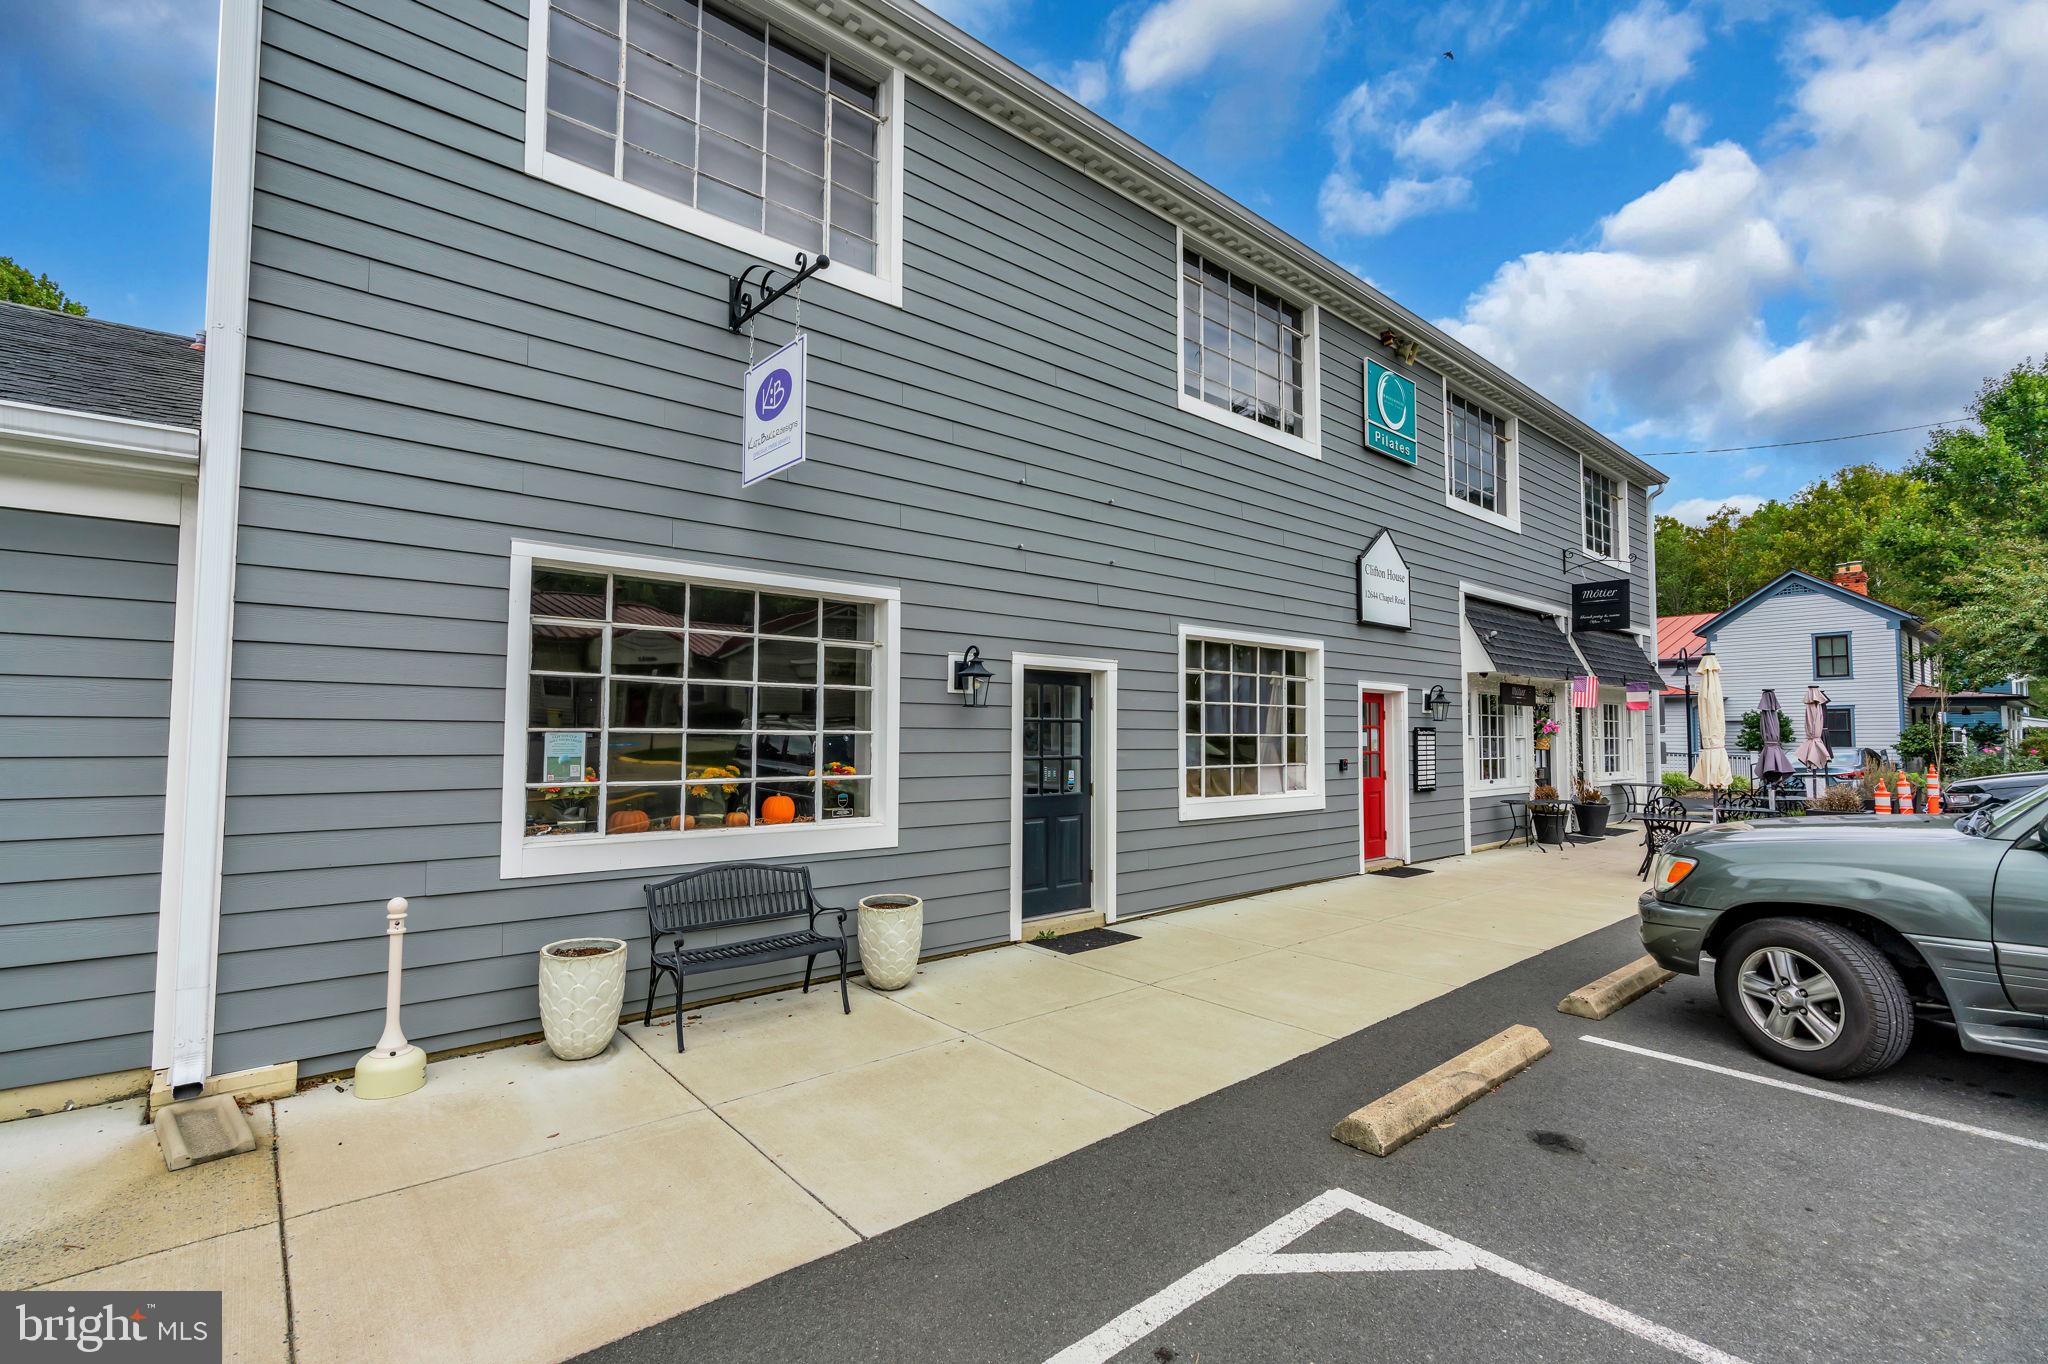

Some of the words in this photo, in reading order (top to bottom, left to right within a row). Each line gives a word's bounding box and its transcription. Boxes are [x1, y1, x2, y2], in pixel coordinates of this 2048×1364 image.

[1375, 431, 1410, 456] Pilates
[1365, 563, 1386, 579] Clifton
[1387, 569, 1405, 583] House
[1379, 592, 1393, 605] Chapel
[1394, 596, 1406, 605] Road
